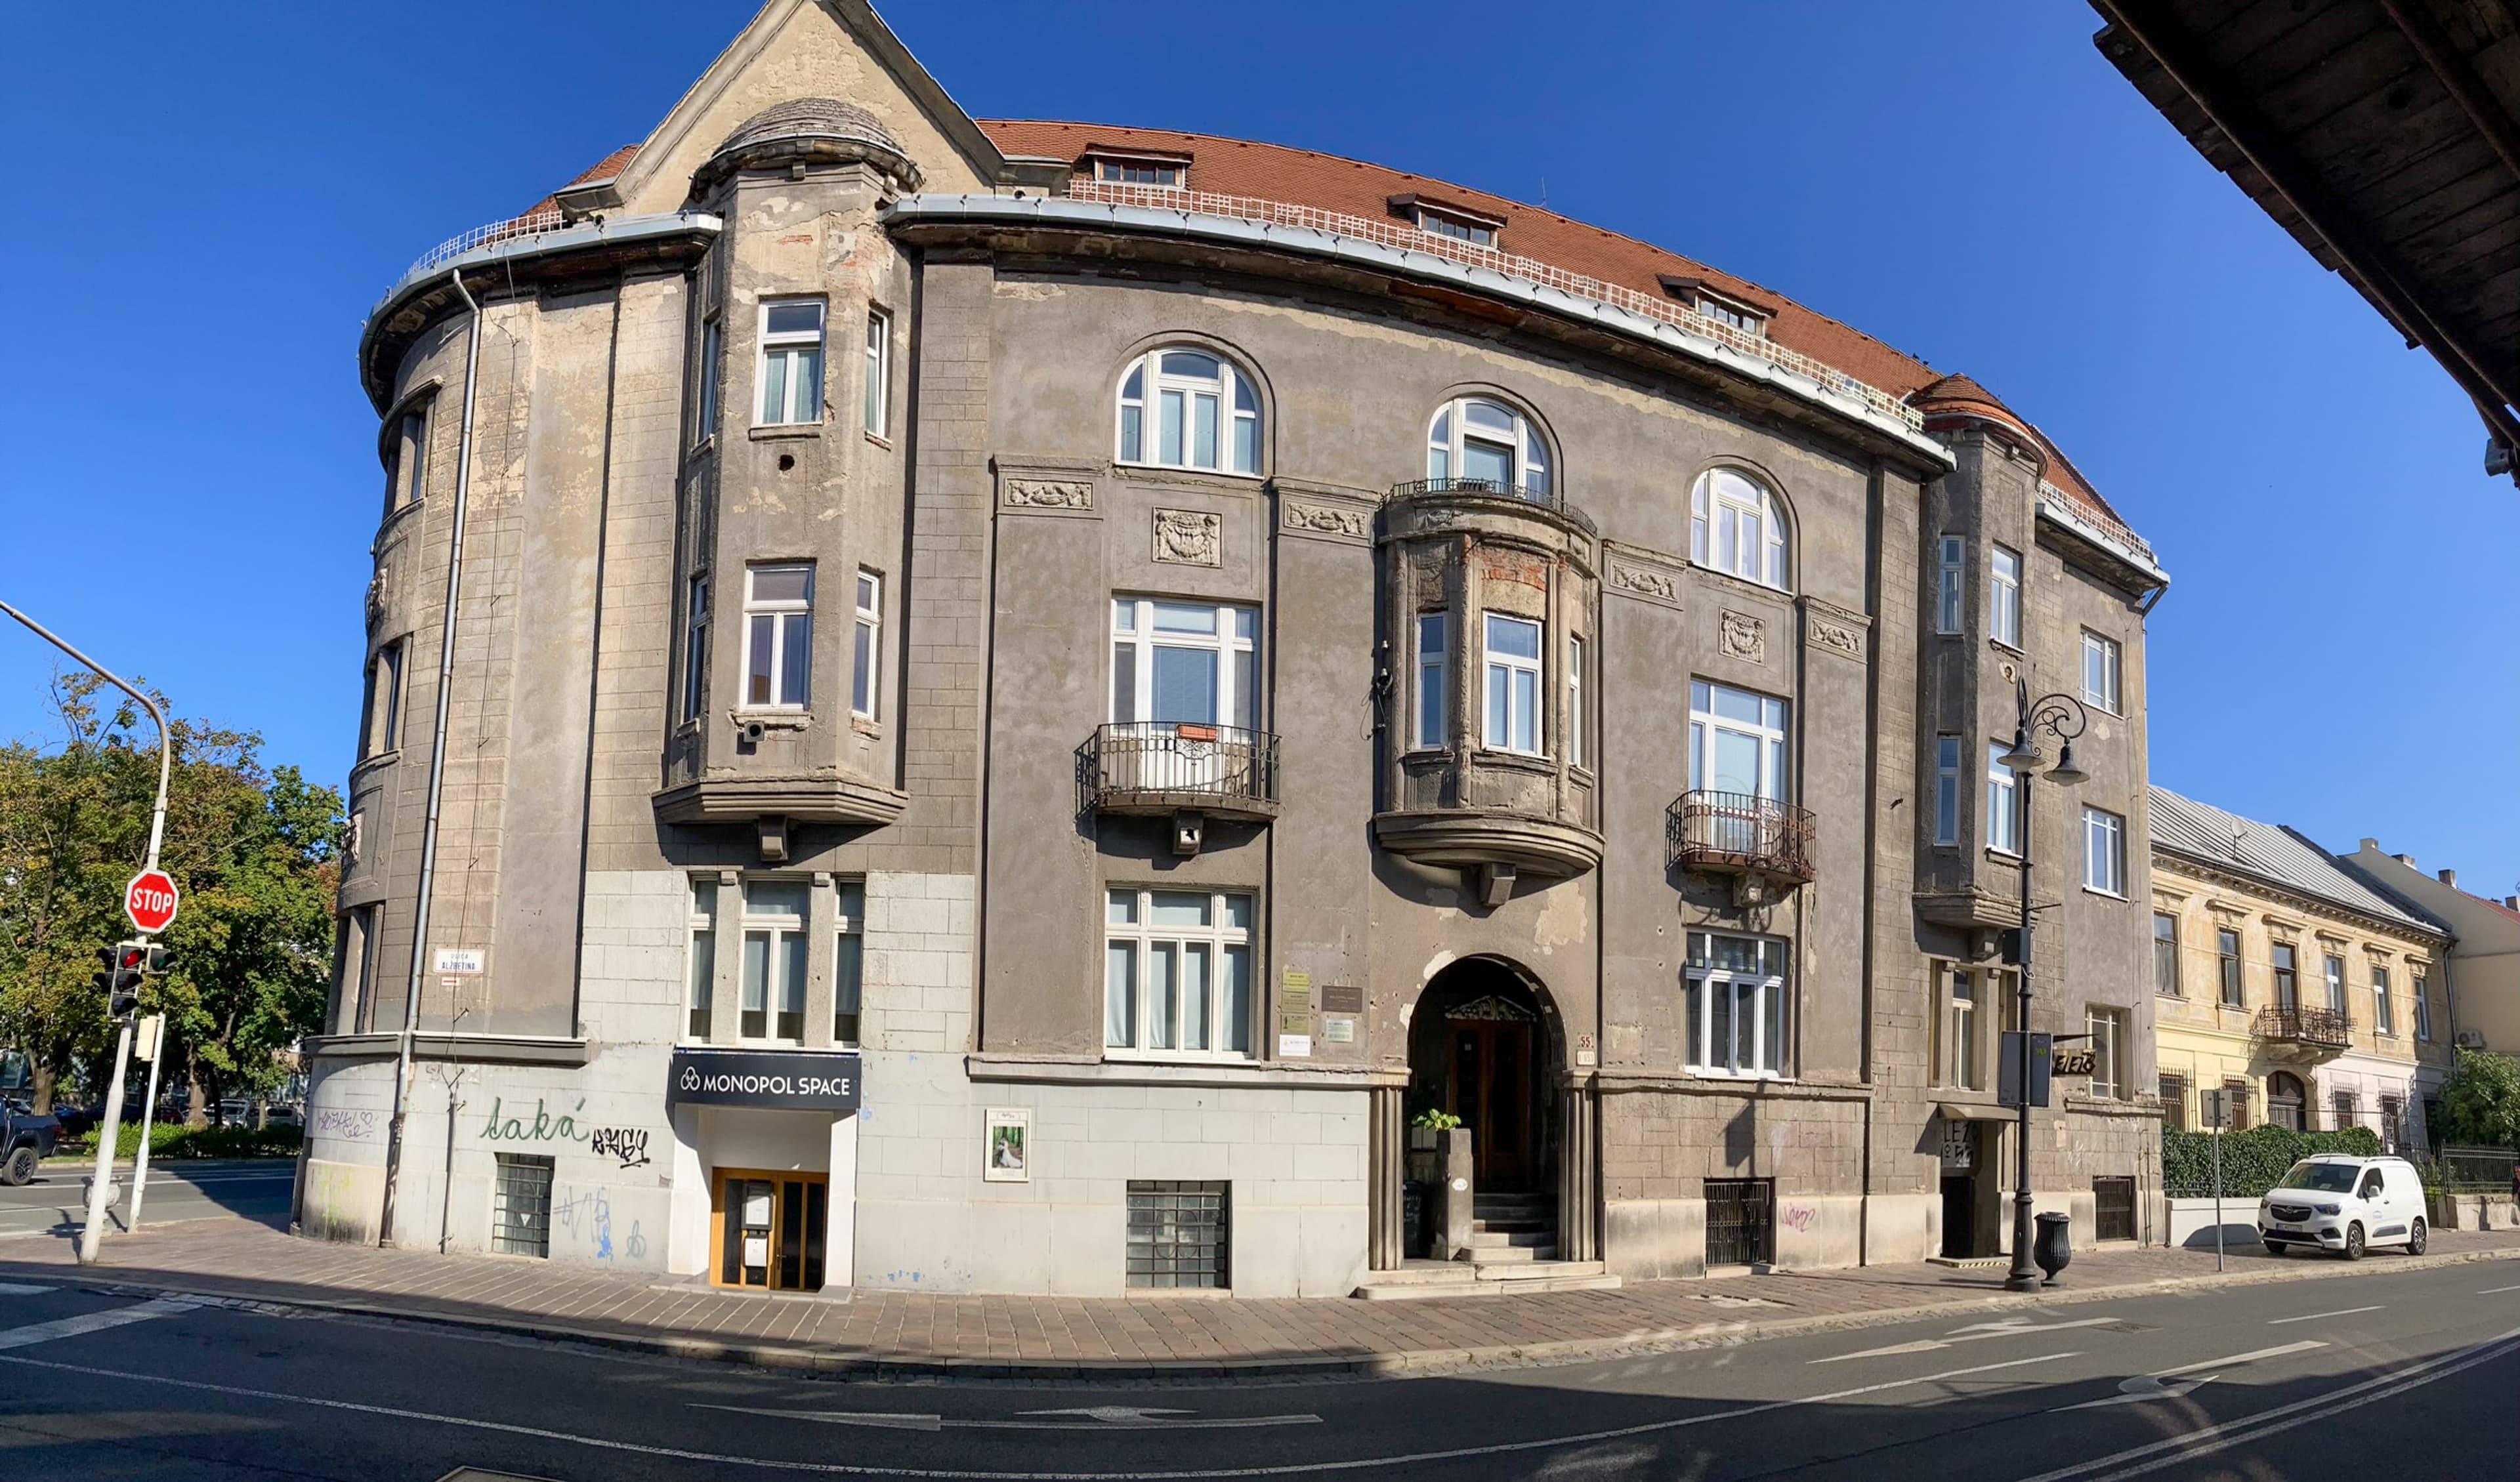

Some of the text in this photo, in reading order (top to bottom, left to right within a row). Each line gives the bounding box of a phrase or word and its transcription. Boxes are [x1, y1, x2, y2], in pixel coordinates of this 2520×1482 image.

[132, 888, 173, 913] STOP
[1581, 1036, 1591, 1048] 55
[703, 1075, 850, 1095] MONOPOL SPACE
